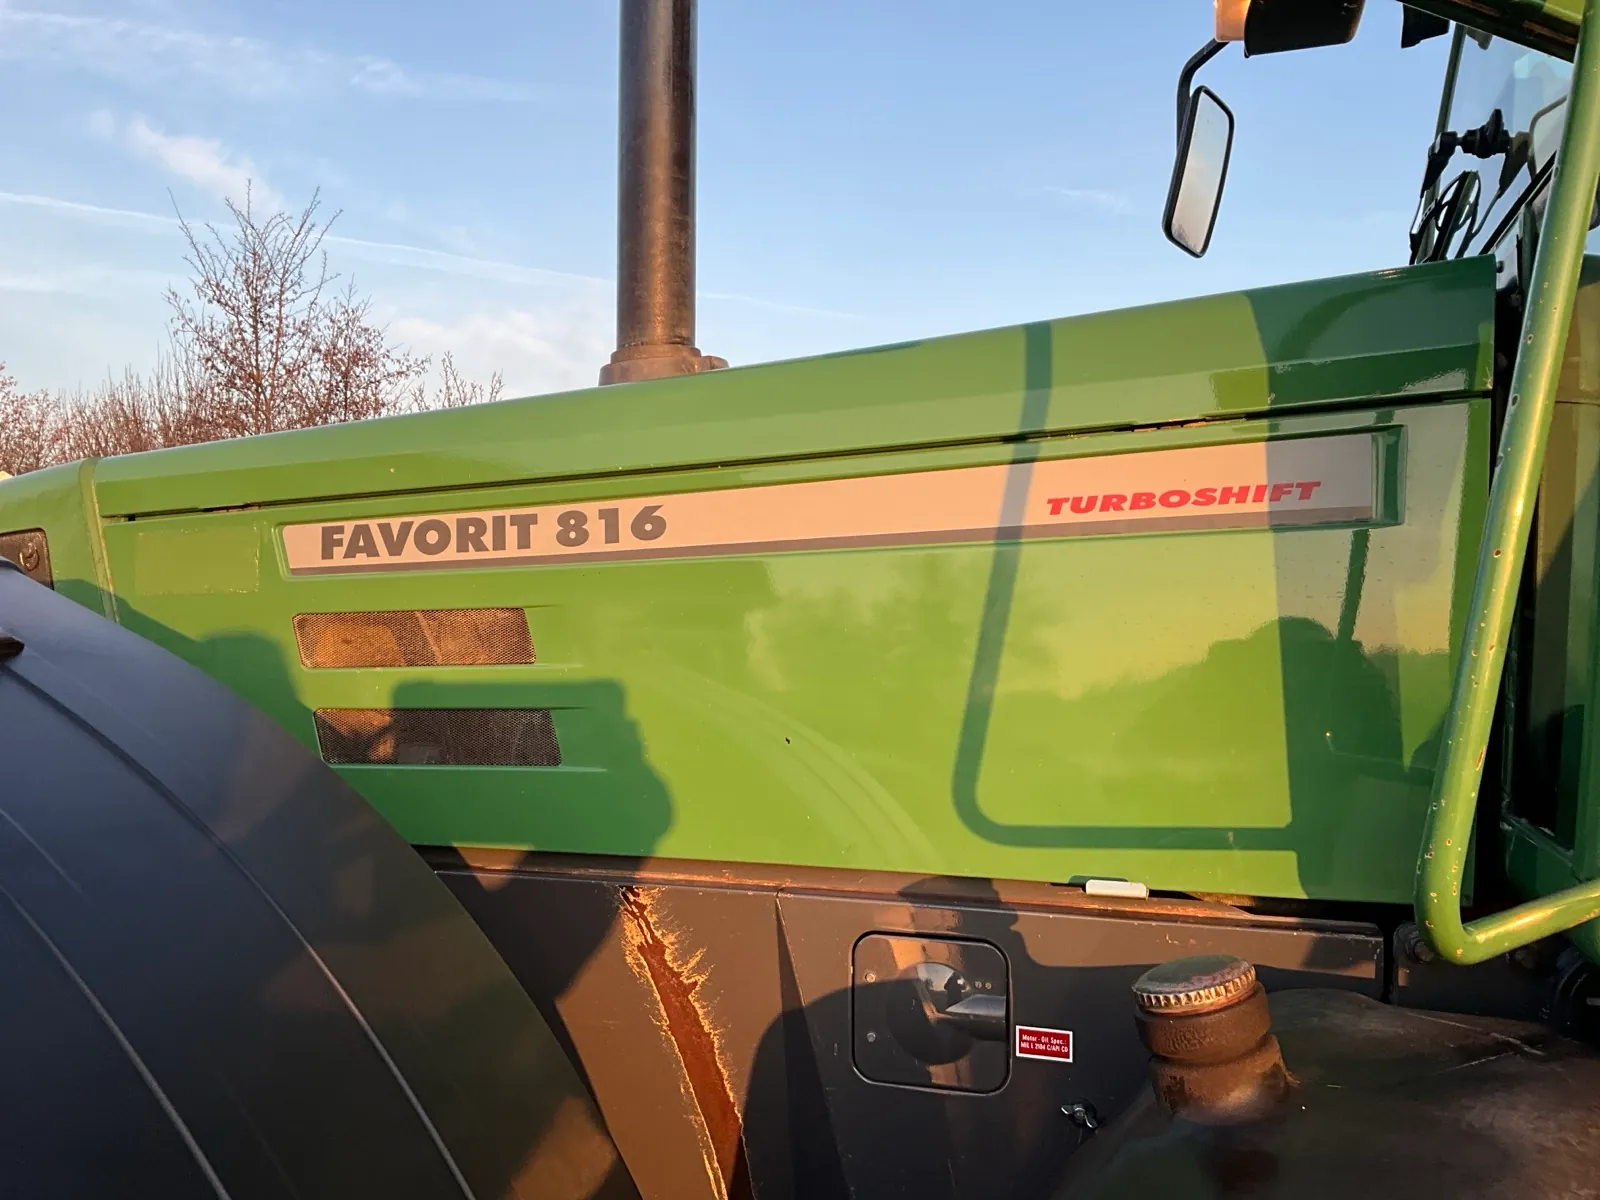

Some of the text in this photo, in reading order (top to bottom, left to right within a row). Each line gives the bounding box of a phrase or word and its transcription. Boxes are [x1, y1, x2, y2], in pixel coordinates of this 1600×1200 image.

[1046, 481, 1321, 516] TURBOSHIFT
[321, 504, 667, 560] FAVORIT 816
[1022, 1034, 1037, 1042] Motor
